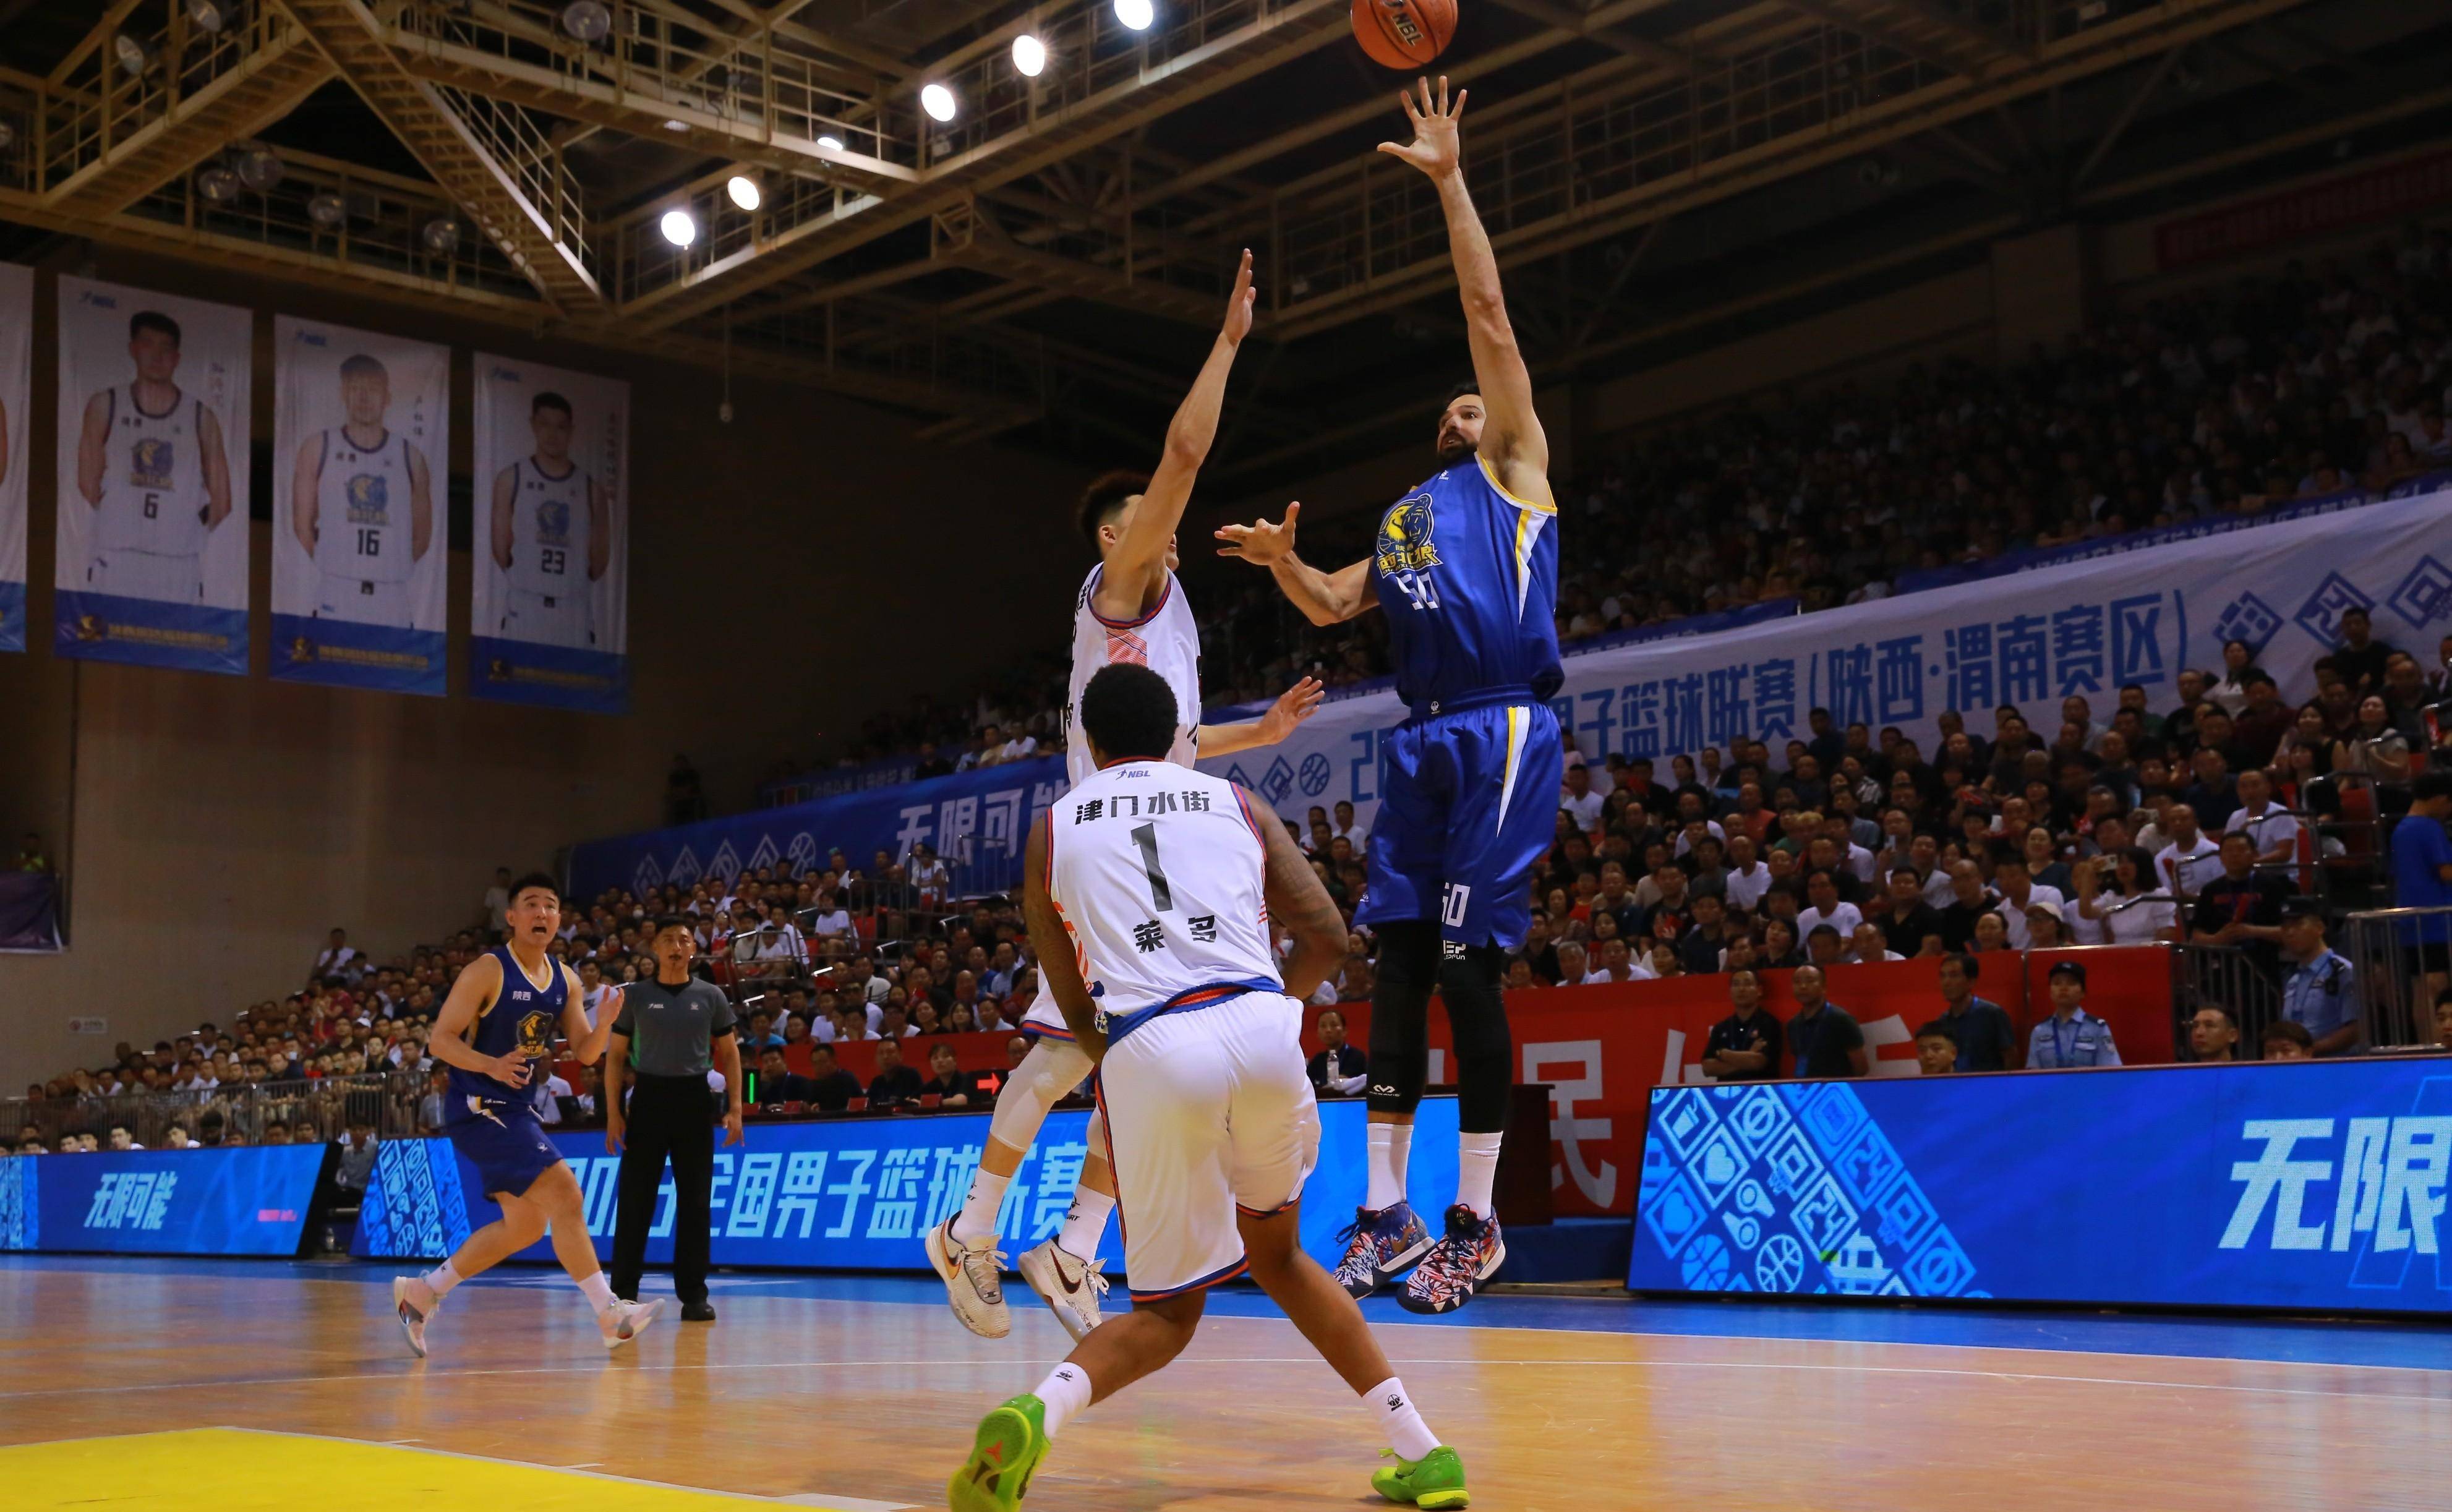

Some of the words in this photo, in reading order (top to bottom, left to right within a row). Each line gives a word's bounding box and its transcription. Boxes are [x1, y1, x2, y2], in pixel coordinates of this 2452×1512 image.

[1392, 13, 1424, 46] NBL
[143, 493, 159, 519] 6
[357, 529, 380, 557] 16
[541, 549, 565, 575] 23
[1395, 571, 1440, 610] 50
[1127, 770, 1151, 779] NBL
[1075, 791, 1210, 826] 津门水街
[1130, 822, 1173, 912] 1
[1133, 915, 1217, 954] 莱多
[513, 991, 531, 1001] 陕西
[83, 1171, 178, 1230] 无限可能
[2218, 1115, 2452, 1255] 无限
